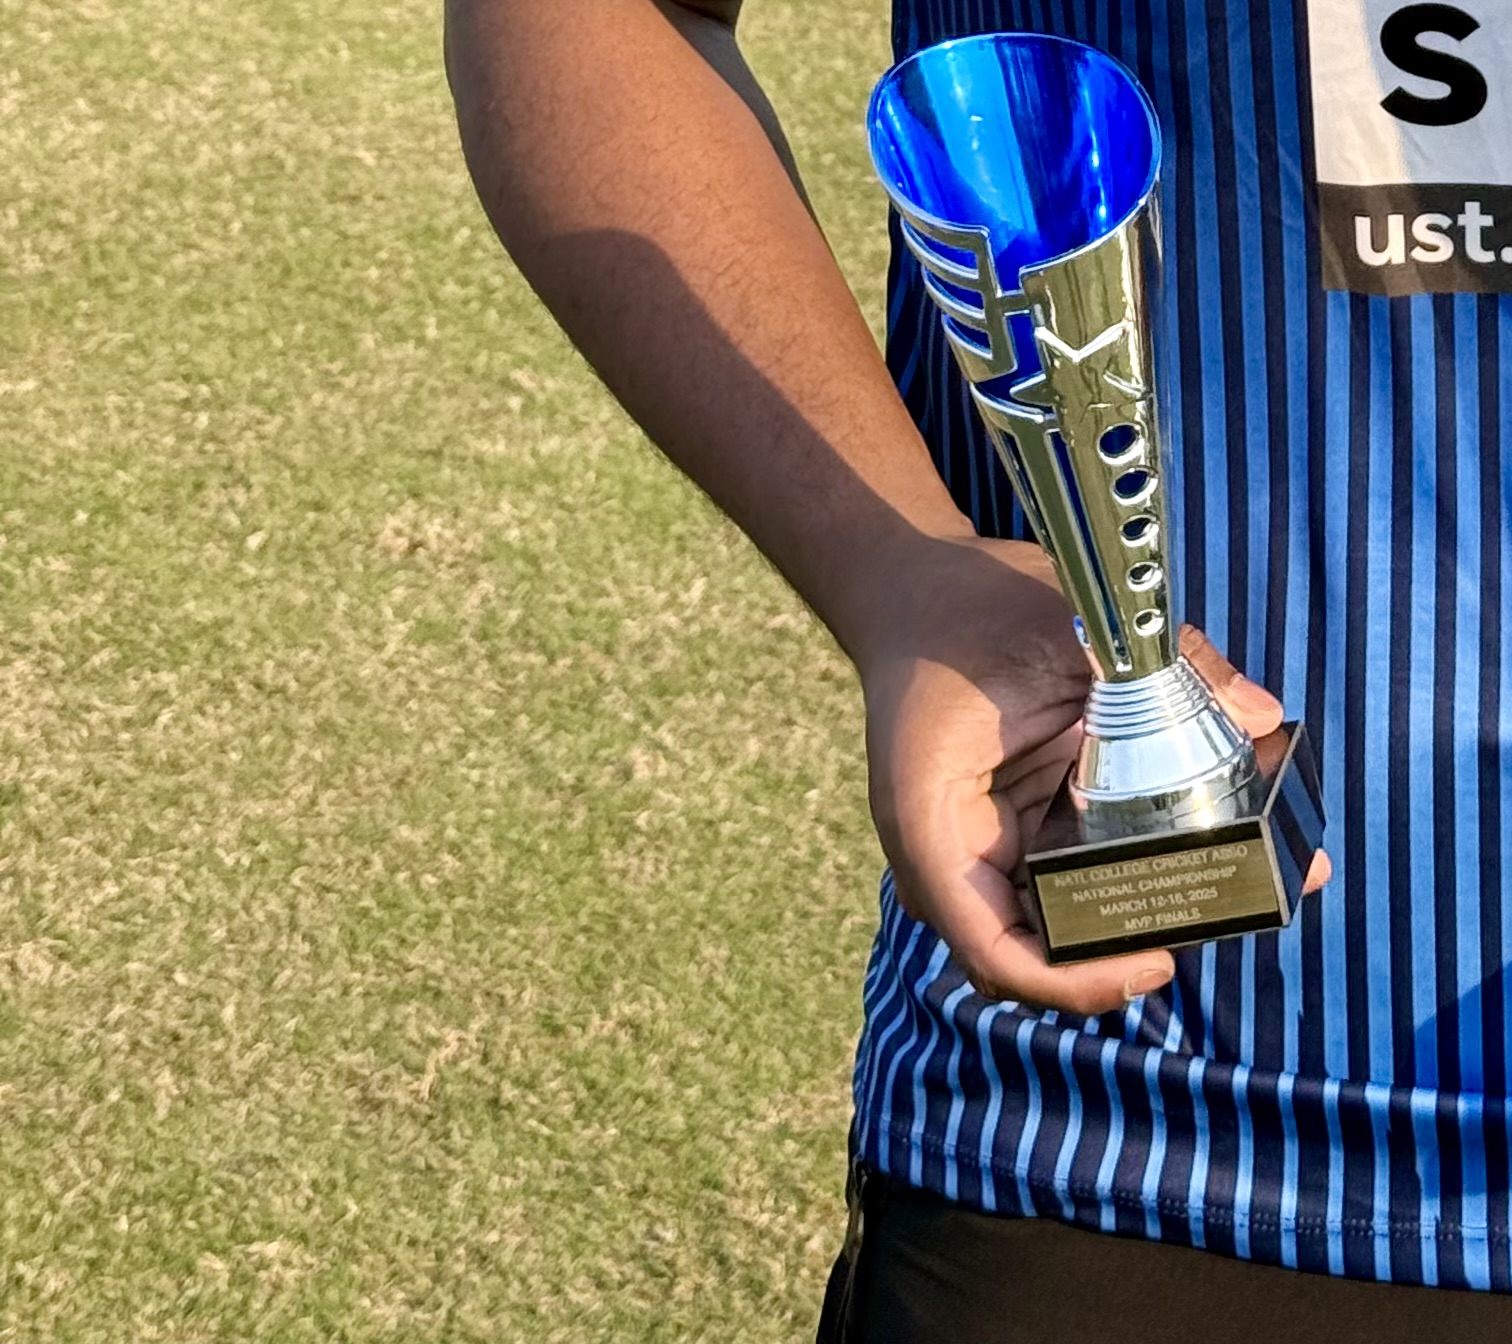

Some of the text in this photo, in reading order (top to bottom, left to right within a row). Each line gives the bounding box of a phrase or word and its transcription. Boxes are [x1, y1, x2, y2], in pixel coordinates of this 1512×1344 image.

[1072, 864, 1237, 903] NATIONAL CHAMPIONSHIP
[1099, 898, 1148, 916] MARCH
[1187, 886, 1219, 901] 2025
[1124, 907, 1202, 930] MVP FINALS
